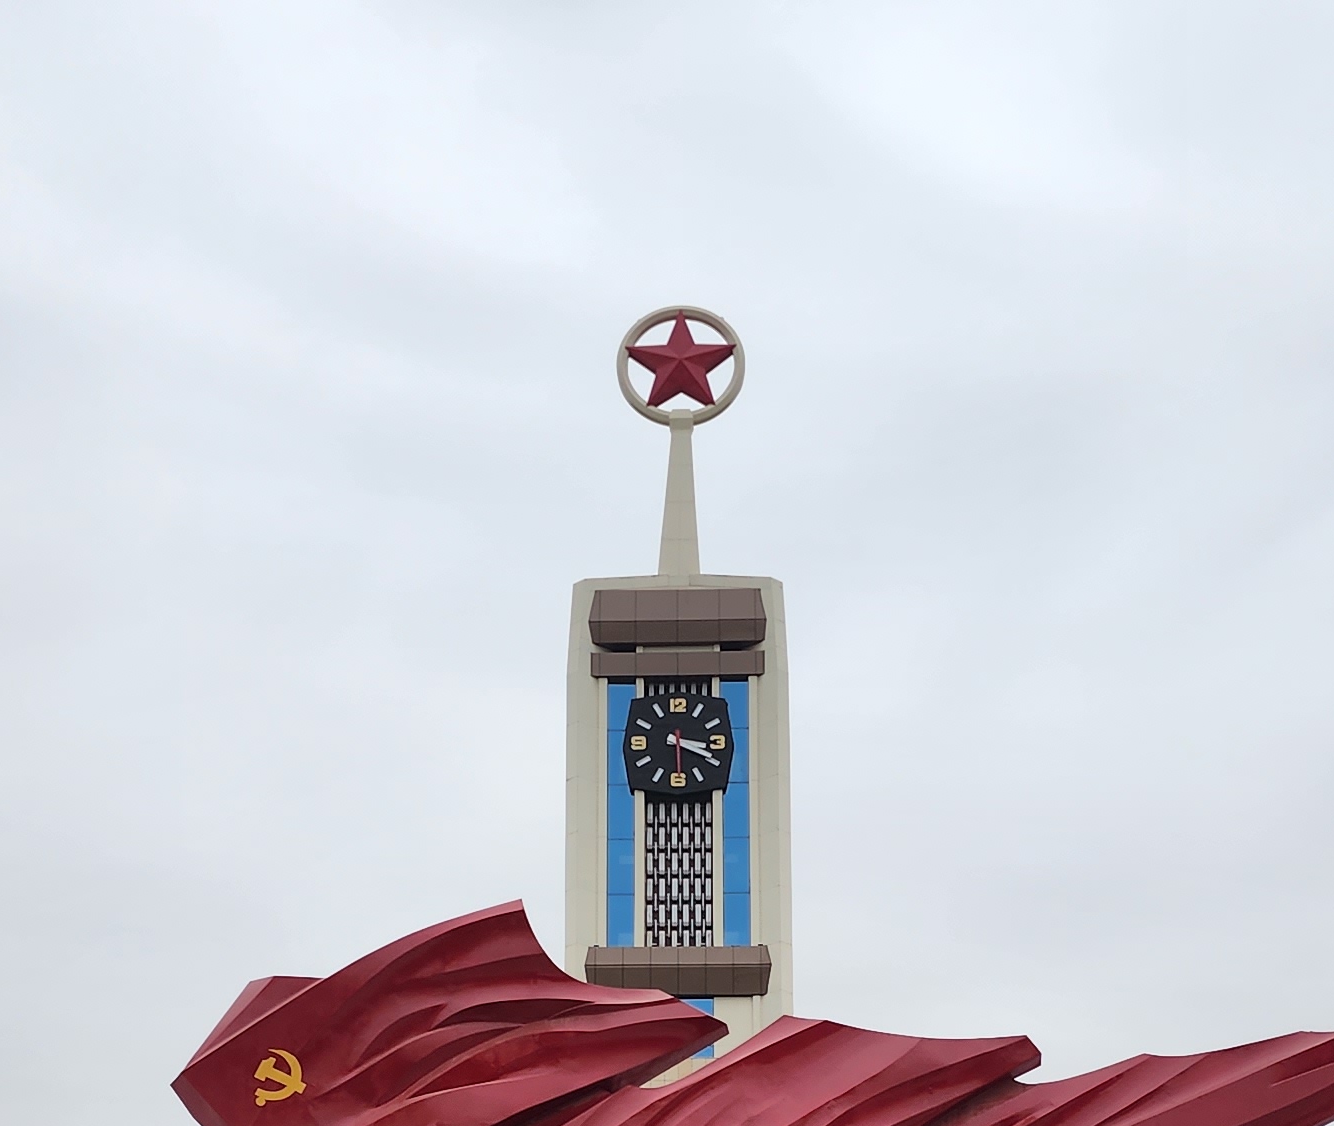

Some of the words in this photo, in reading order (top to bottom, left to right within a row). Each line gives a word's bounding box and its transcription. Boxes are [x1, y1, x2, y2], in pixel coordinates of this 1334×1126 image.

[669, 698, 687, 713] 12
[630, 735, 647, 750] 9
[709, 735, 726, 750] 3
[670, 773, 687, 787] 6
